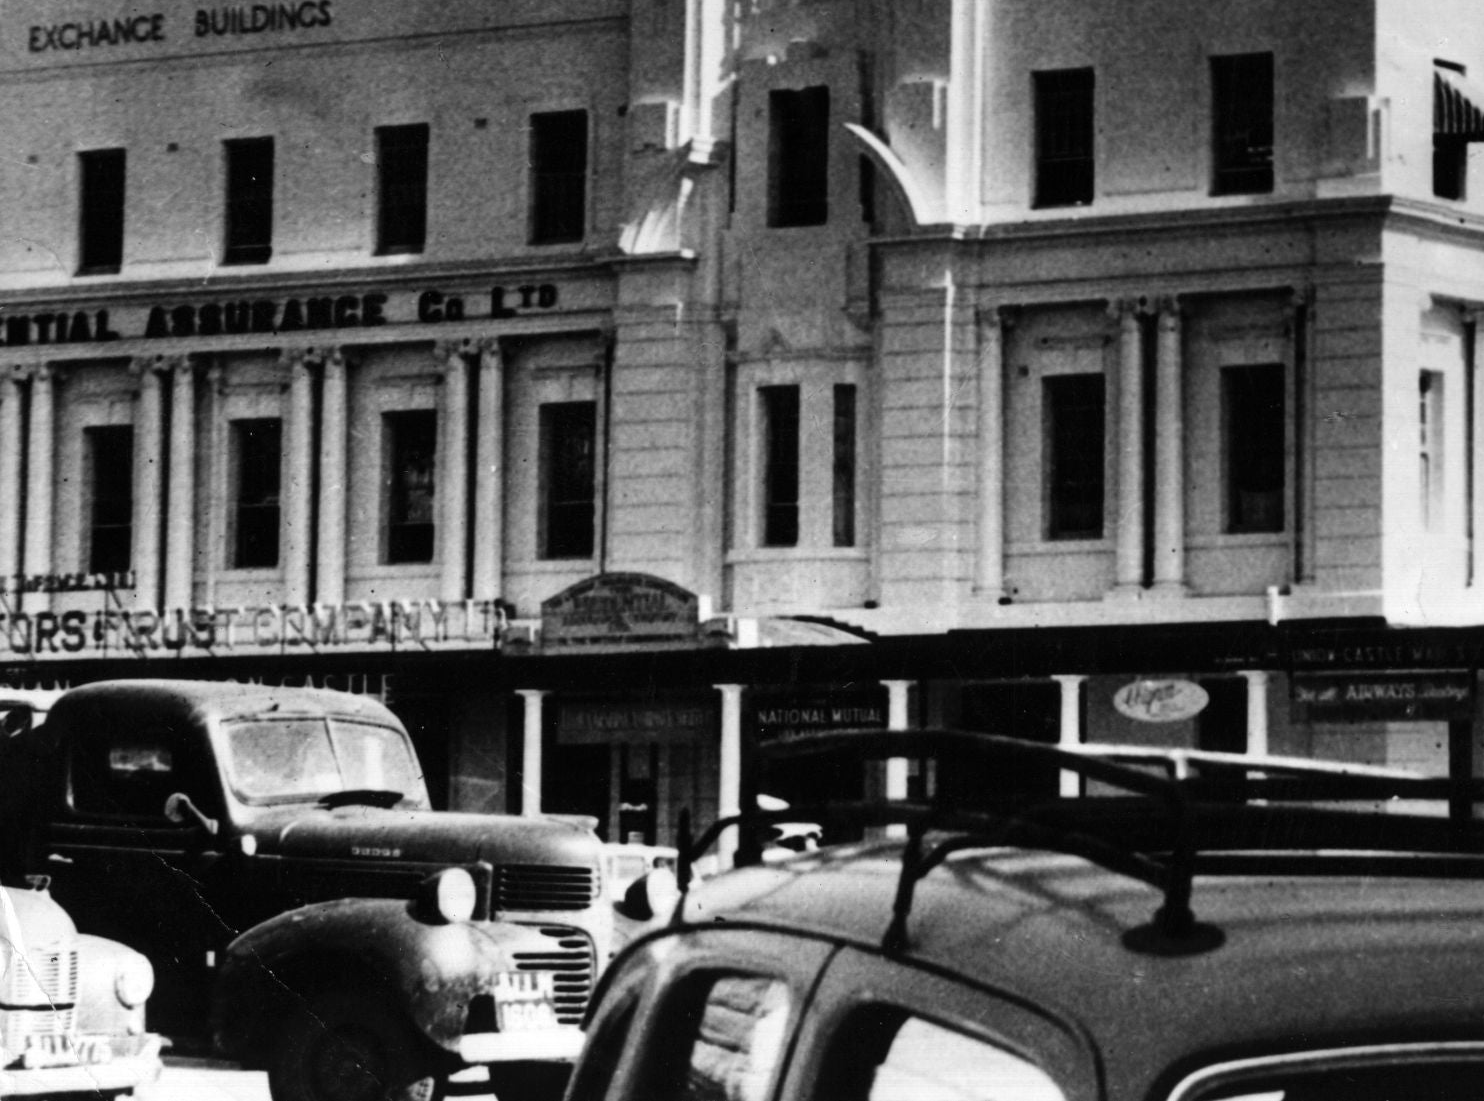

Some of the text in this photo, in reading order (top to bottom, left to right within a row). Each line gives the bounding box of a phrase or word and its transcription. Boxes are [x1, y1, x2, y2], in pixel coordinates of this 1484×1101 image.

[28, 0, 332, 52] EXCHANGE BUILDINGS
[0, 310, 121, 347] NTIAL
[145, 294, 388, 339] ASSURANCE
[256, 602, 446, 646] COMPANY
[1346, 683, 1415, 699] AIRWAYS
[757, 707, 883, 724] NATIONAL MUTUAL
